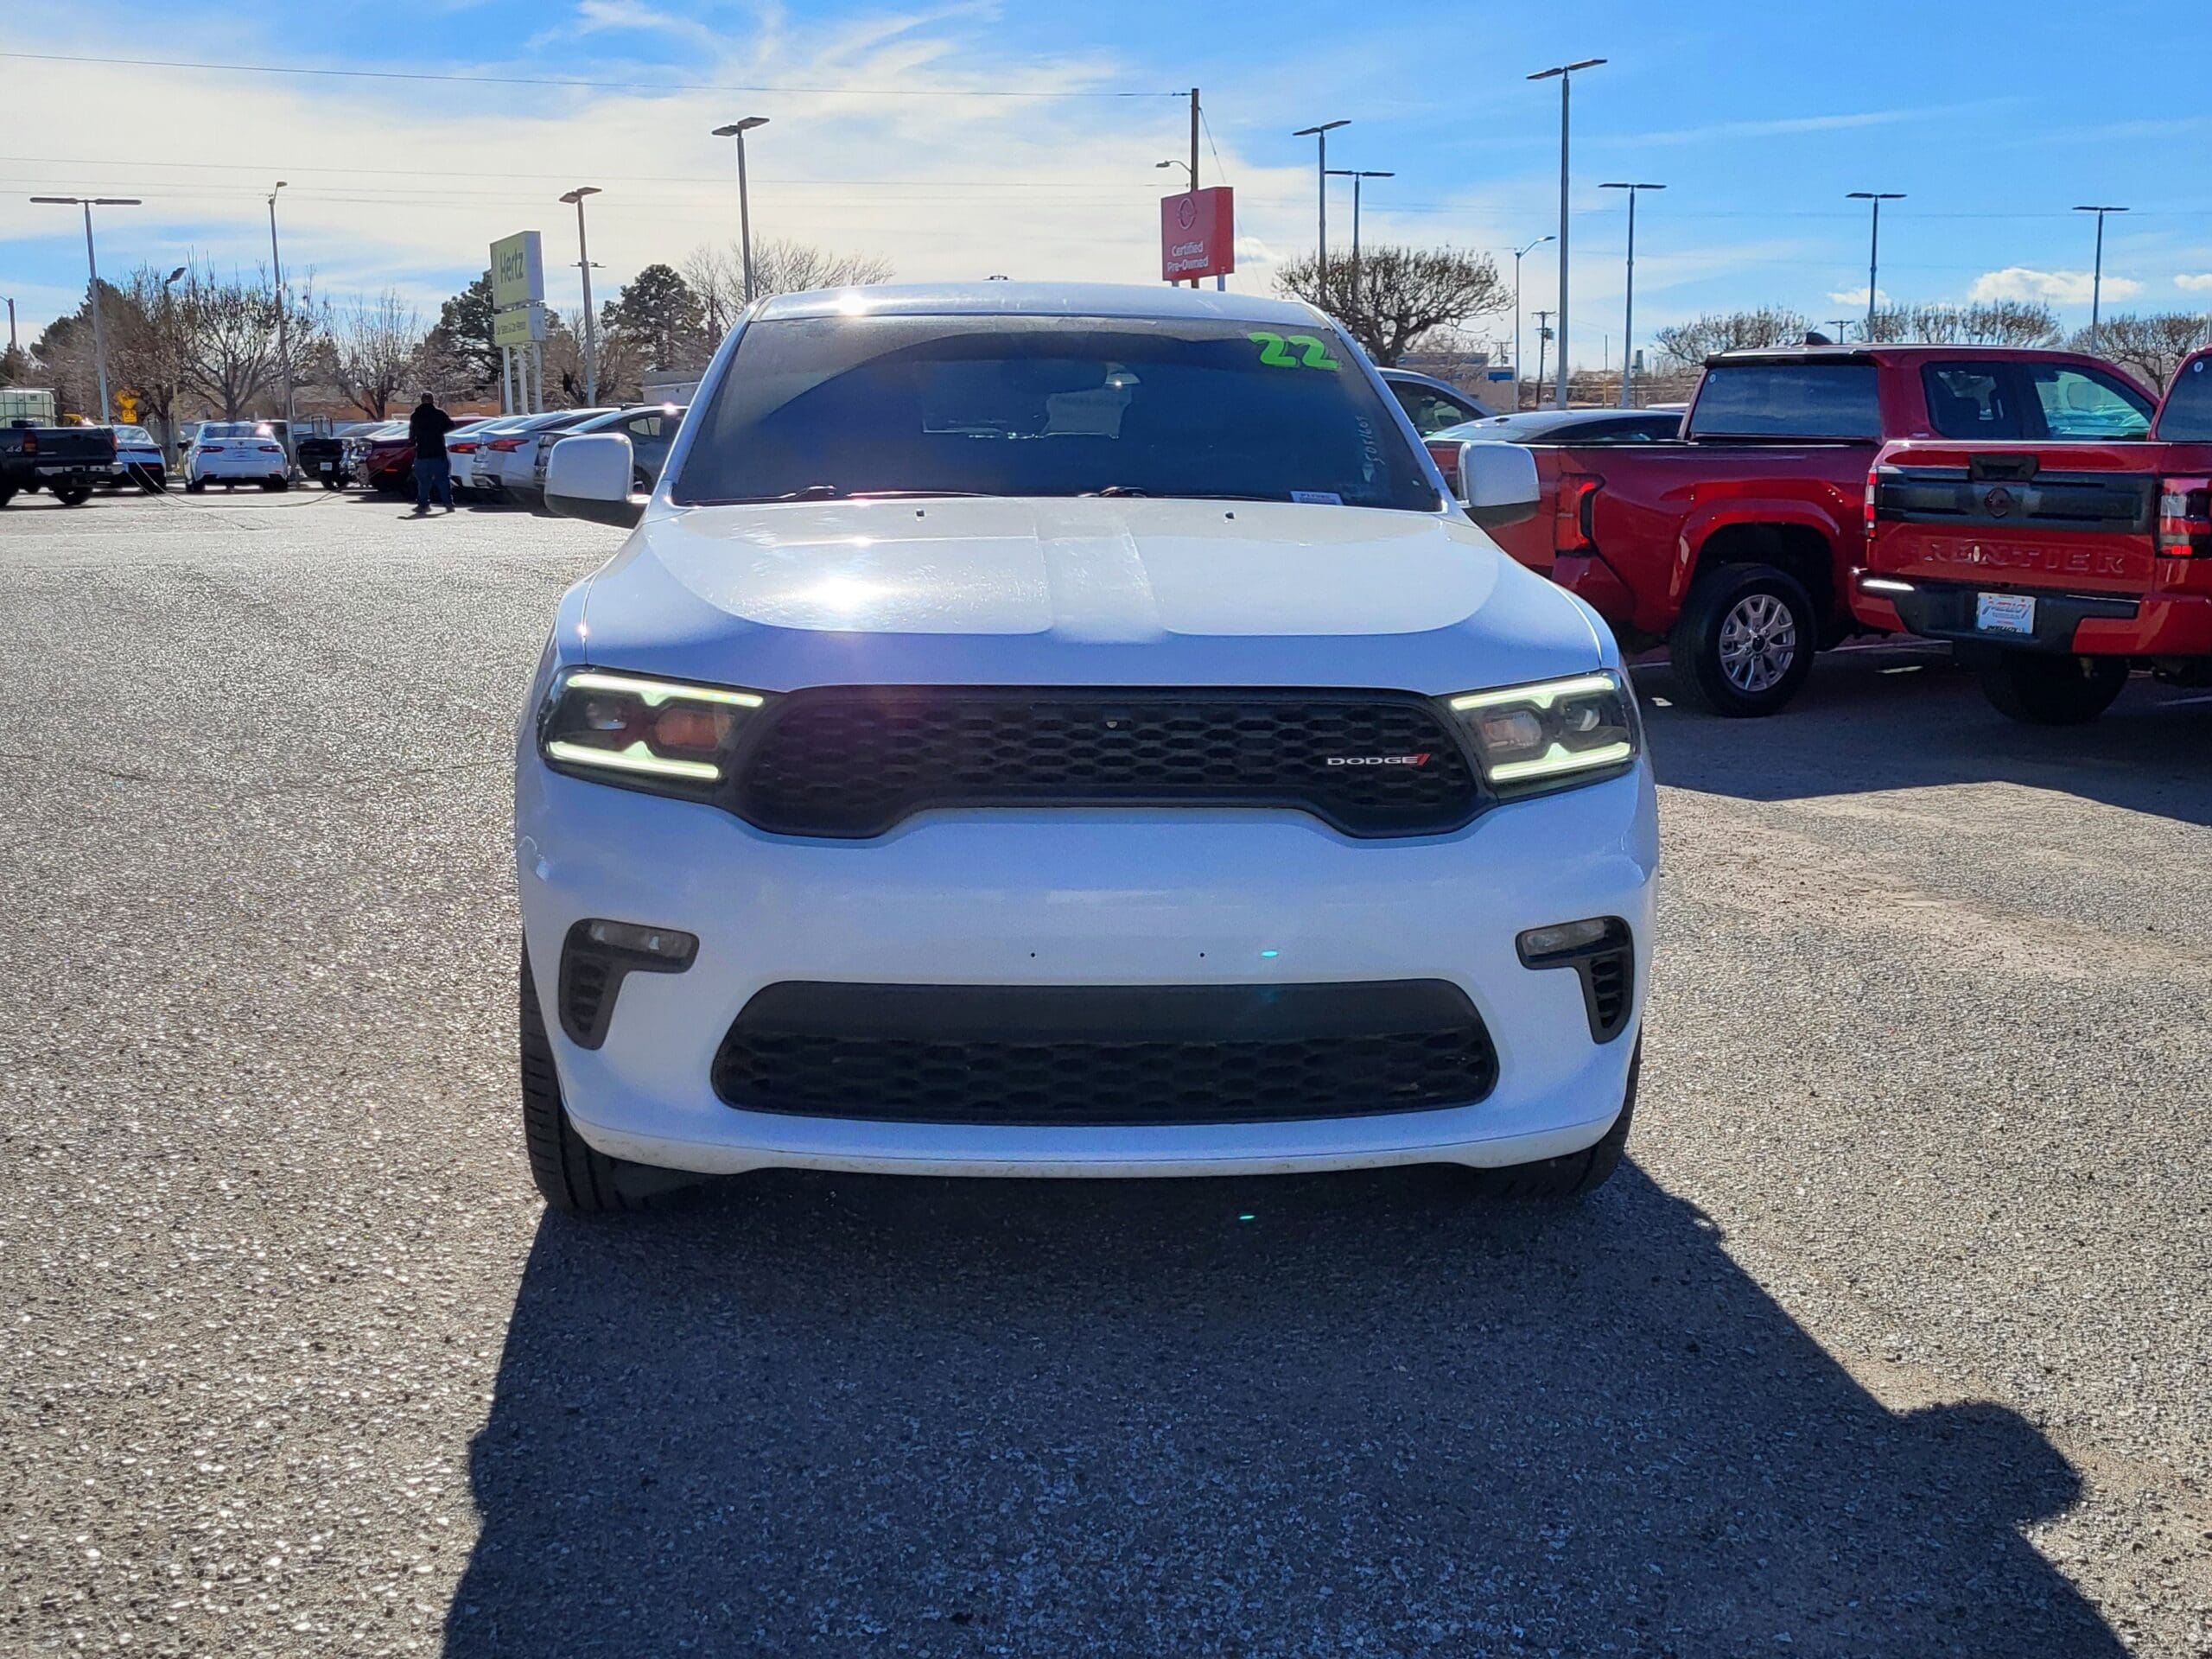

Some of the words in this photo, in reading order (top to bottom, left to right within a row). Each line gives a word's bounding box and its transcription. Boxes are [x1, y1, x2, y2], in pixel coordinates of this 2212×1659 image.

[1172, 241, 1204, 256] Certified
[500, 249, 524, 283] Hertz
[1167, 257, 1208, 271] Pre-Owned
[1248, 332, 1338, 370] 22
[1327, 756, 1419, 766] DODGE
